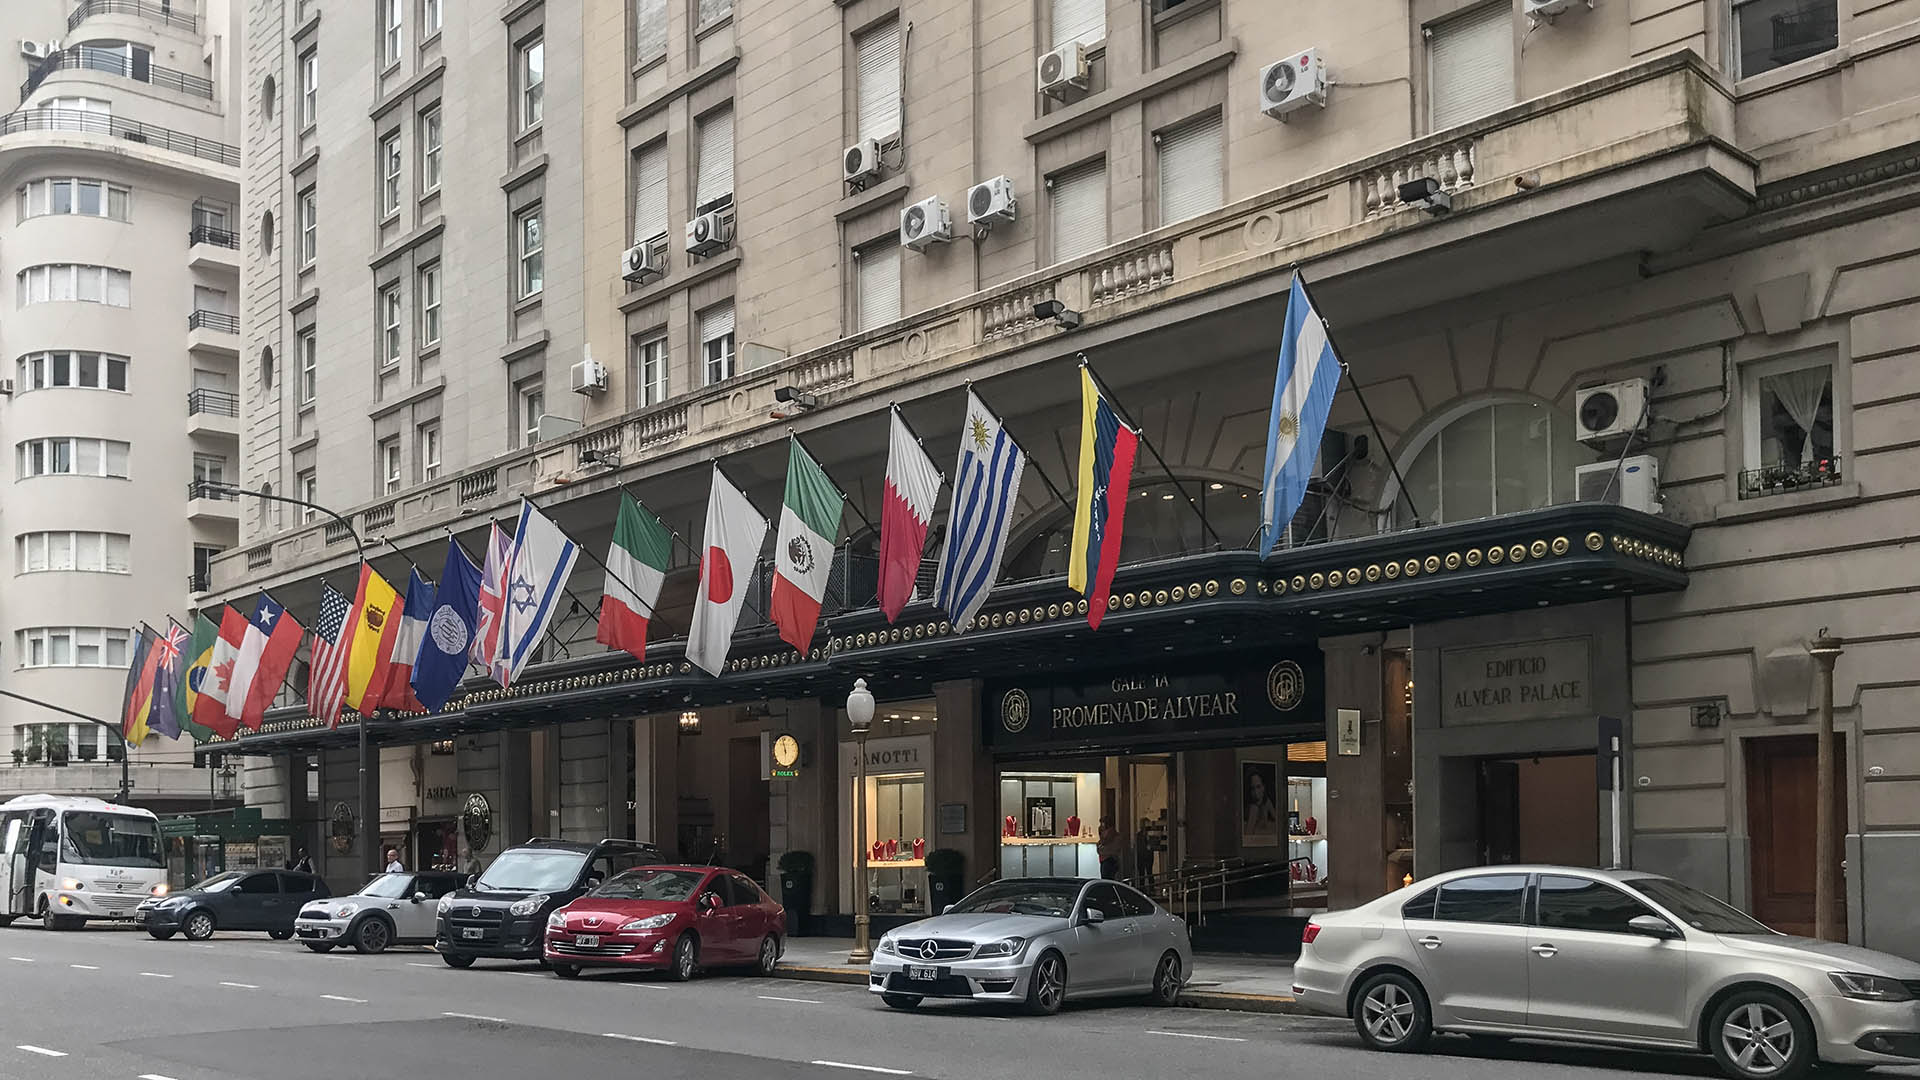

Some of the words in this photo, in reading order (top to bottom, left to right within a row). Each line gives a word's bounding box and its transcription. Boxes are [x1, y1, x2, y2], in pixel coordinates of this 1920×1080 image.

[1486, 657, 1546, 678] EDIFICIO
[1454, 686, 1512, 708] ALVEAR
[1520, 680, 1582, 703] PALACE
[1052, 697, 1159, 729] PROMENADE
[1163, 692, 1239, 720] ALVEAR
